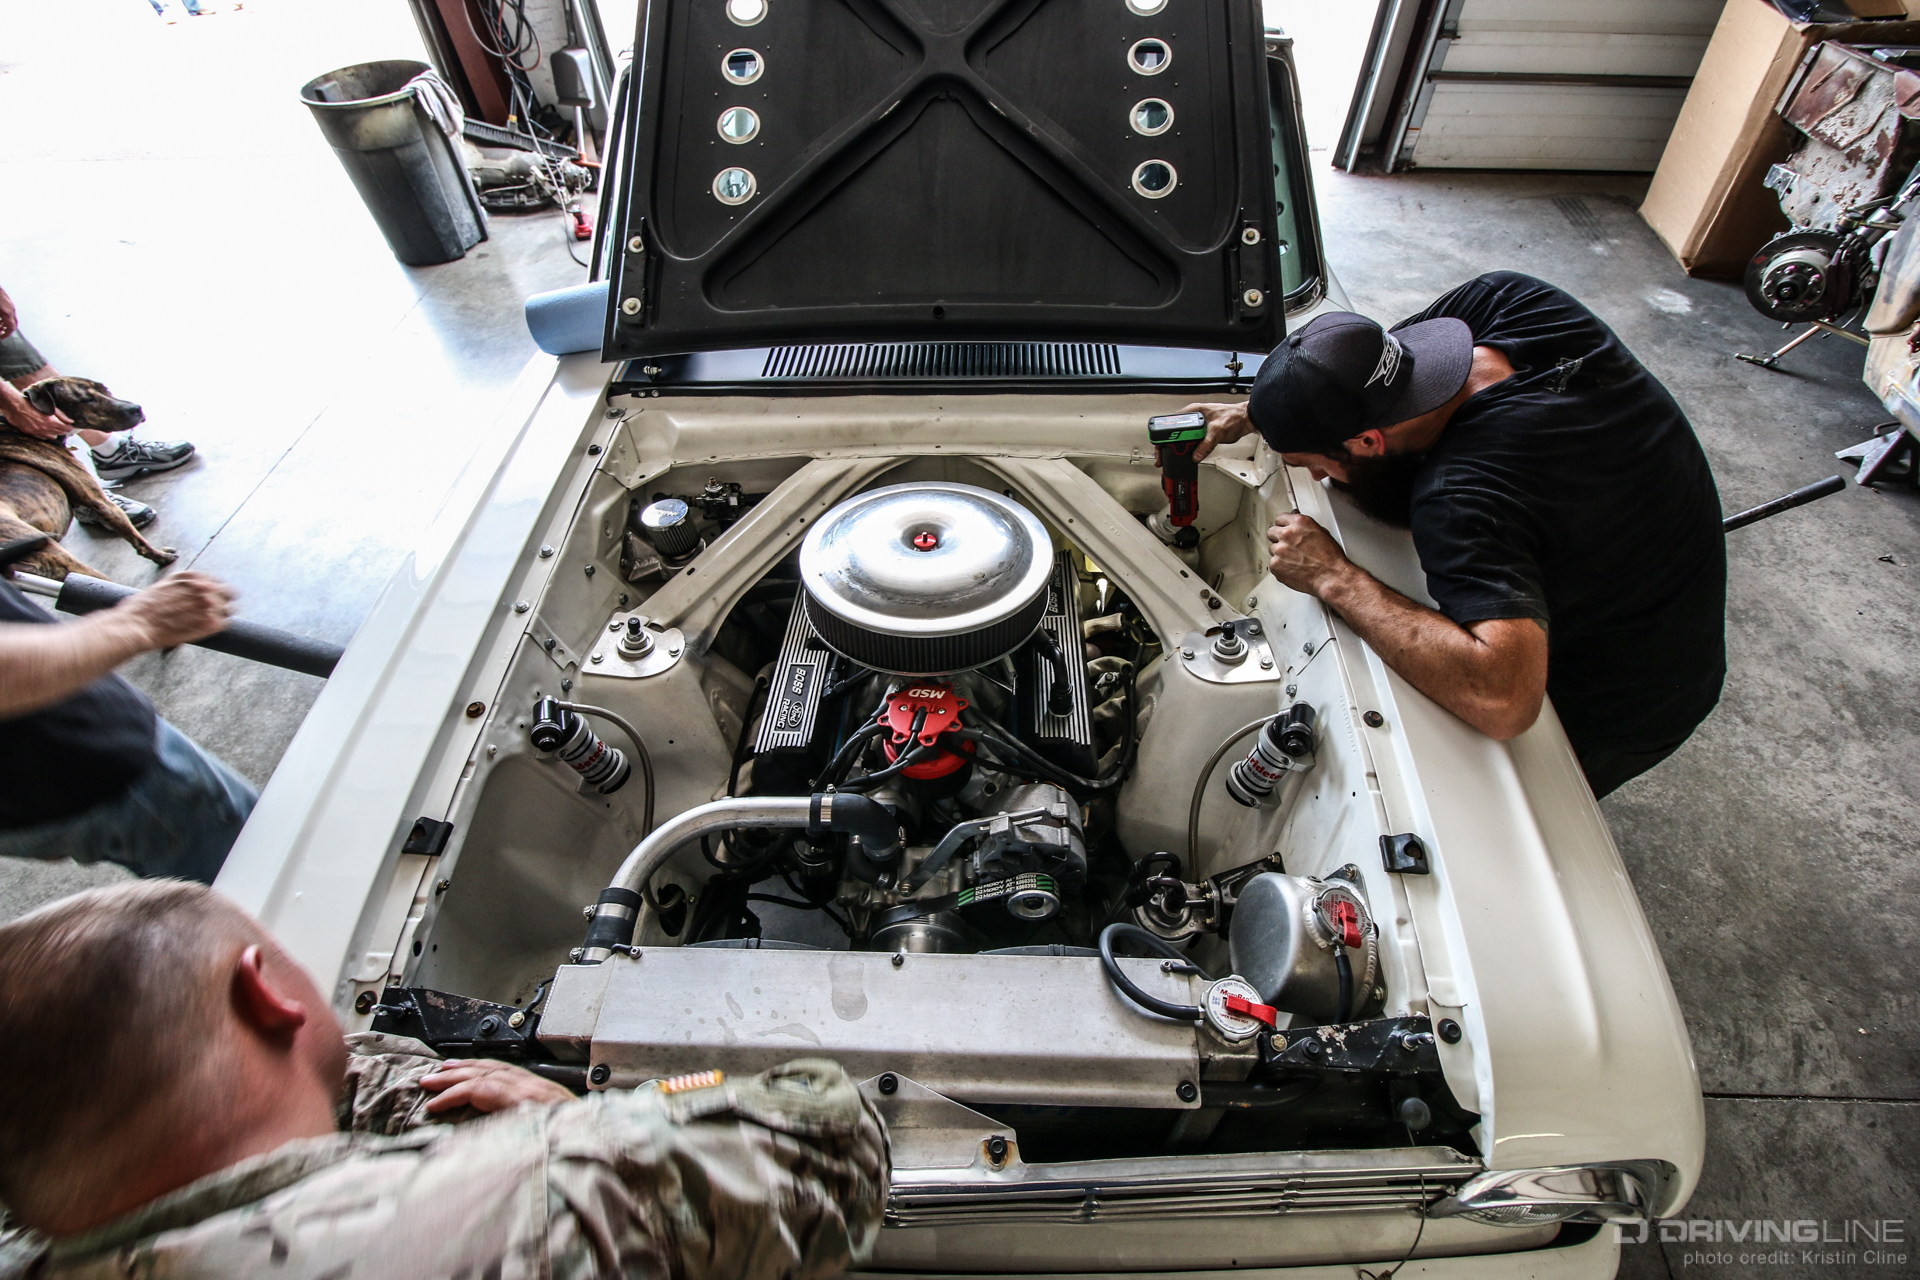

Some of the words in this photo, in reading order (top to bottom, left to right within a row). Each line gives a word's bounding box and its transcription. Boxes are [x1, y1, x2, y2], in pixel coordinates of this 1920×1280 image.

[1048, 592, 1059, 613] BOSS
[792, 667, 806, 695] BOSS
[908, 688, 946, 699] MSD
[776, 698, 791, 729] RACING
[788, 702, 803, 726] Ford
